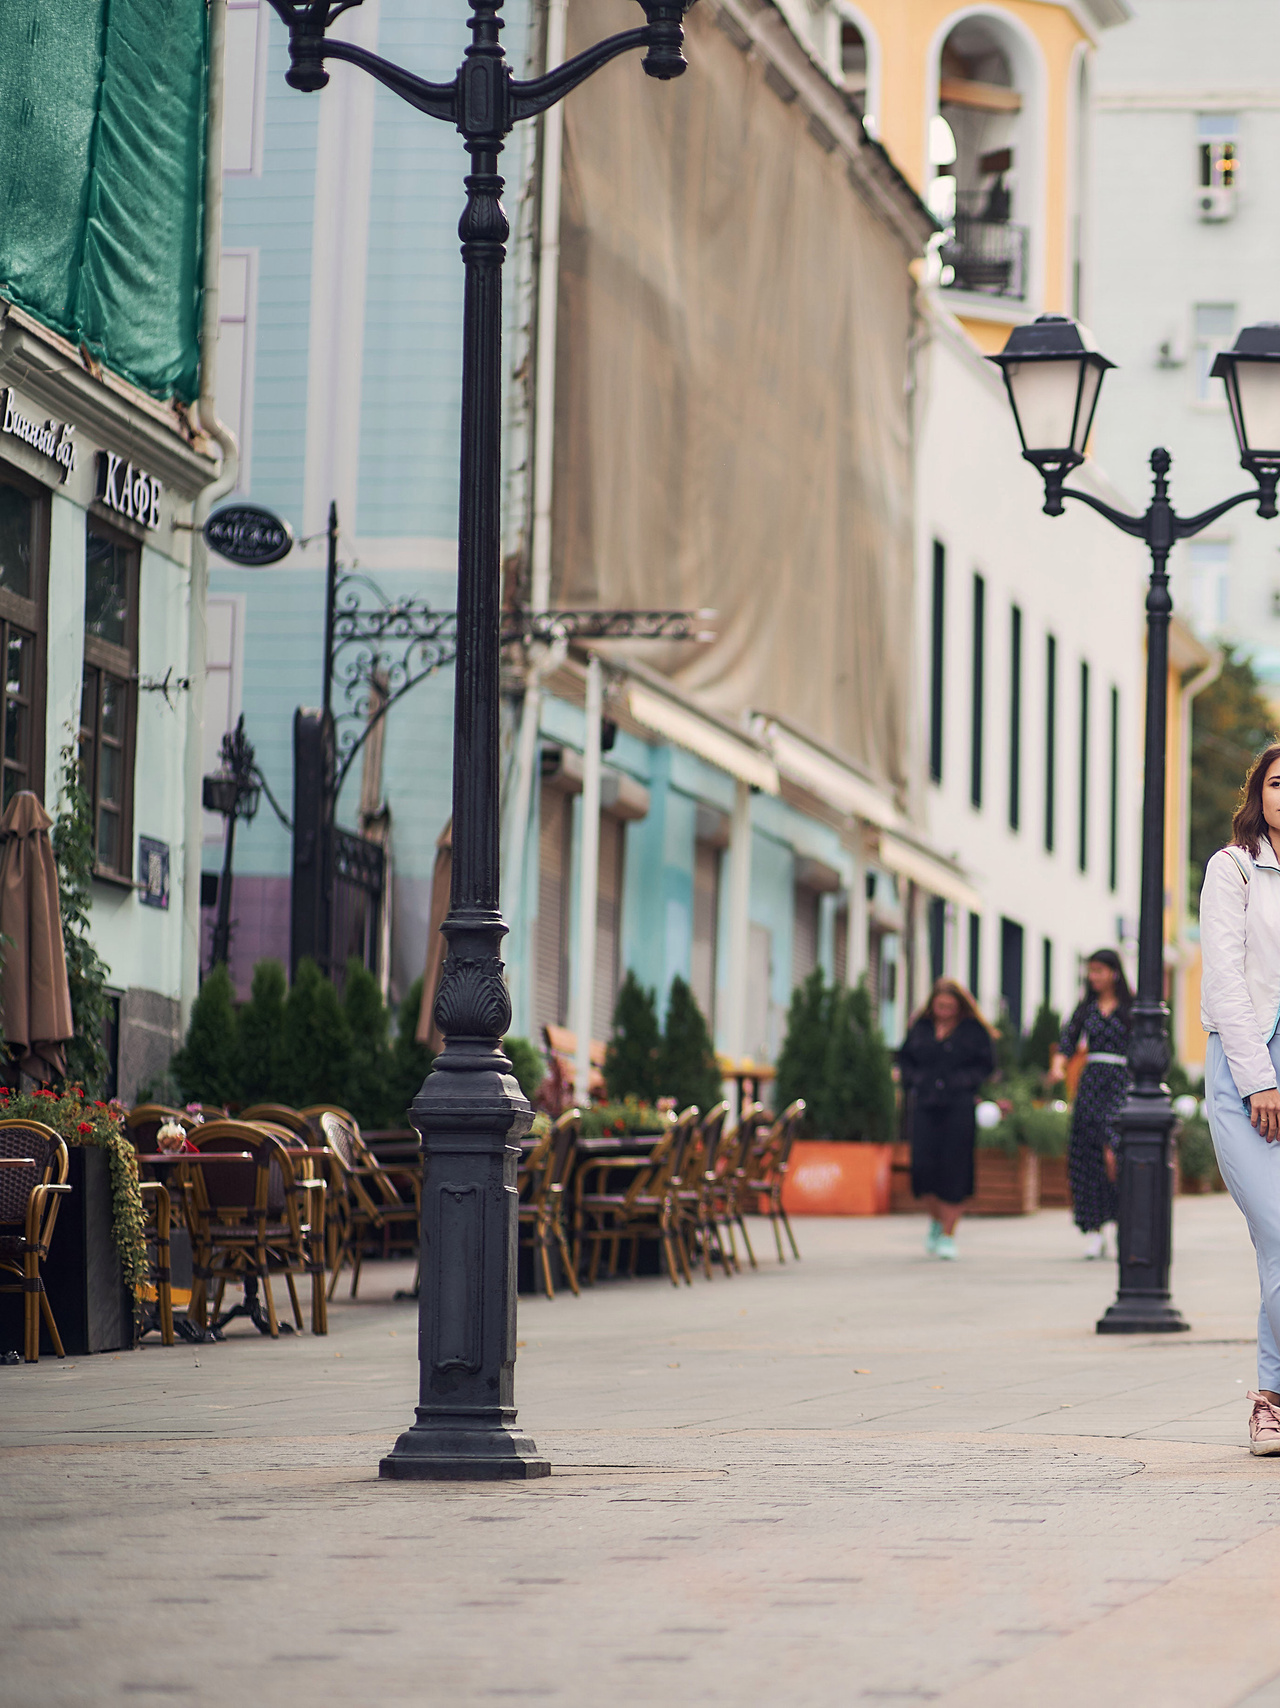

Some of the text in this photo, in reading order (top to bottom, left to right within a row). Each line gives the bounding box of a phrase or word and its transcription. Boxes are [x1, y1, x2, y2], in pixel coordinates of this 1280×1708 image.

[3, 387, 77, 485] Винный бар
[103, 450, 162, 532] КАФЕ
